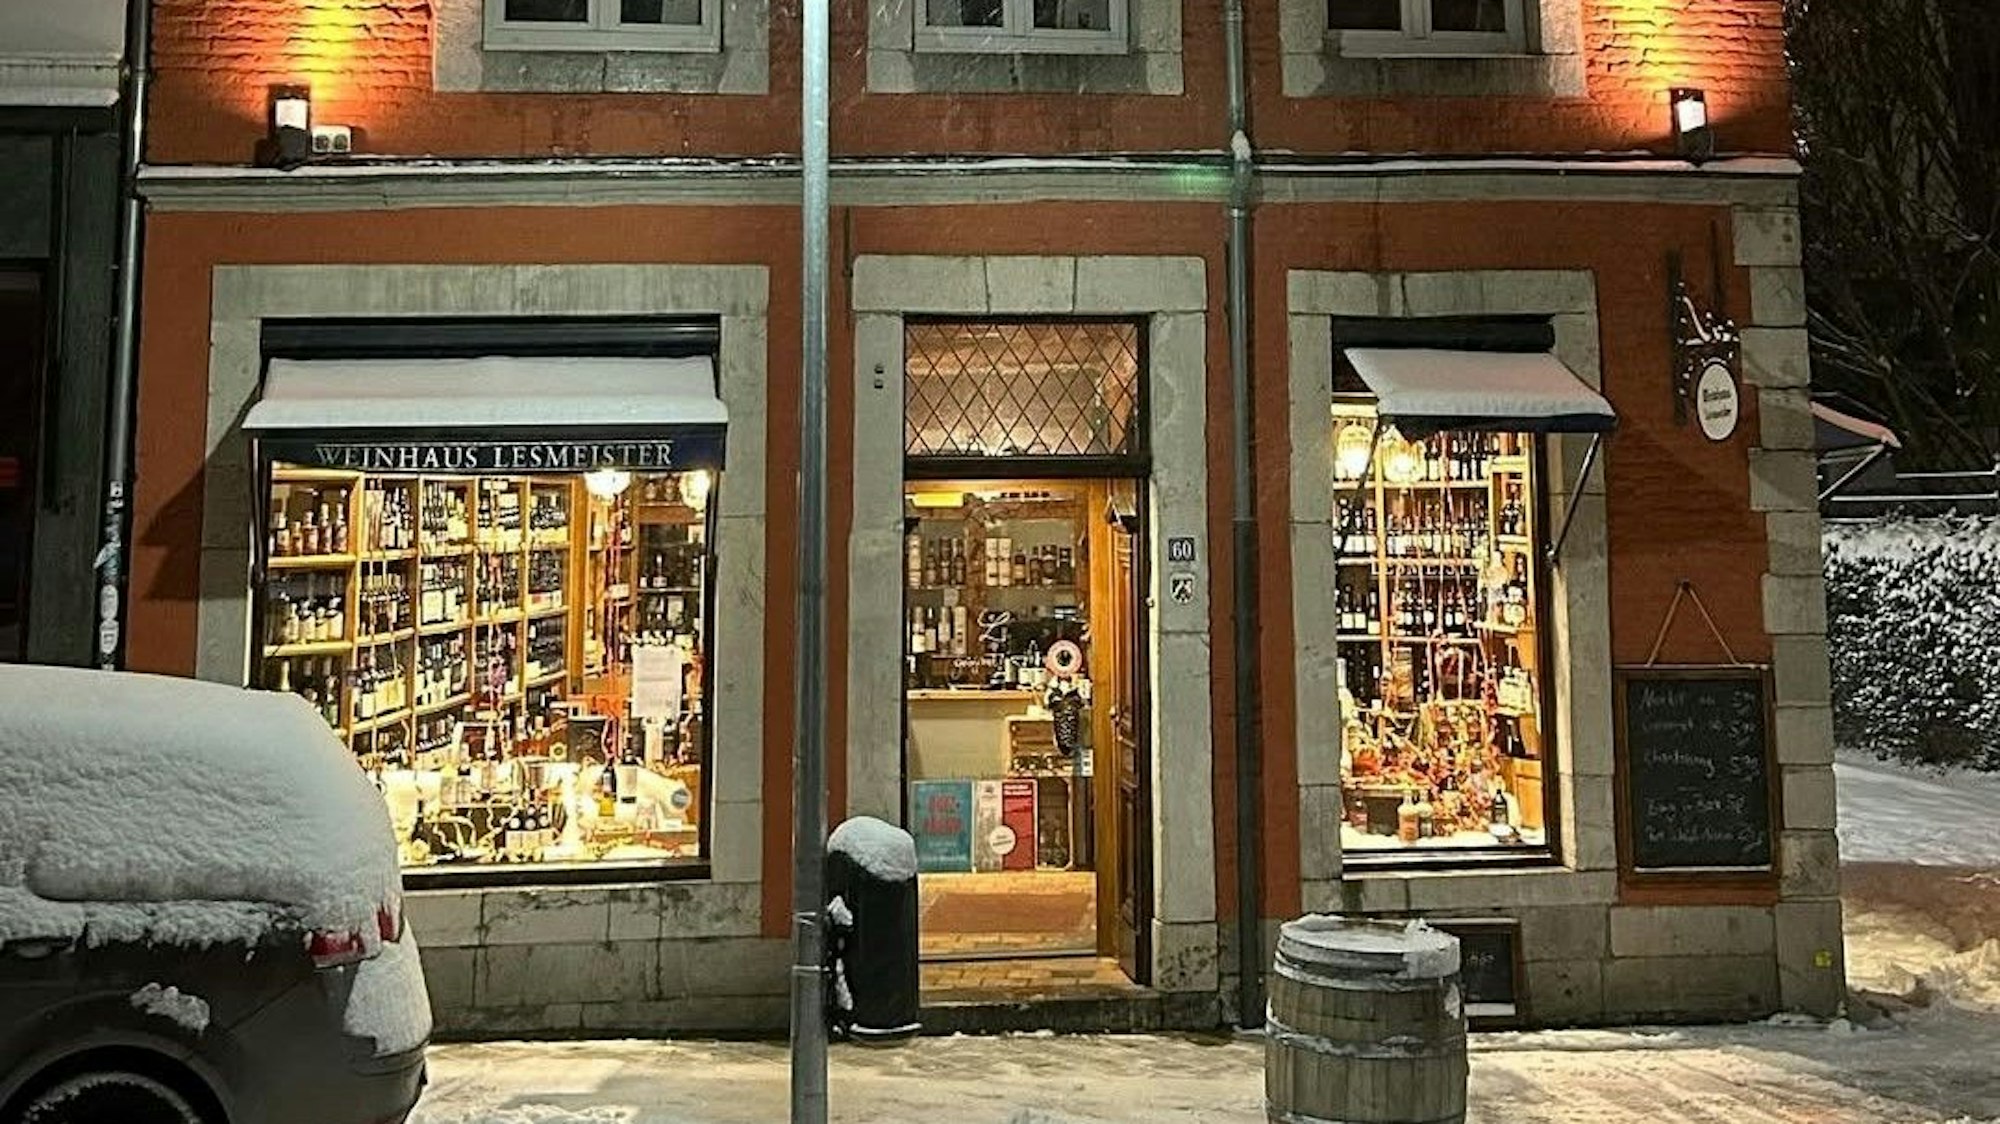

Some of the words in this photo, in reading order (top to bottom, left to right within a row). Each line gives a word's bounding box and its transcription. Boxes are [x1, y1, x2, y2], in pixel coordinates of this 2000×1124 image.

[316, 446, 478, 469] WEINHAUS
[493, 444, 672, 468] LESMEISTER
[1173, 540, 1192, 559] 60
